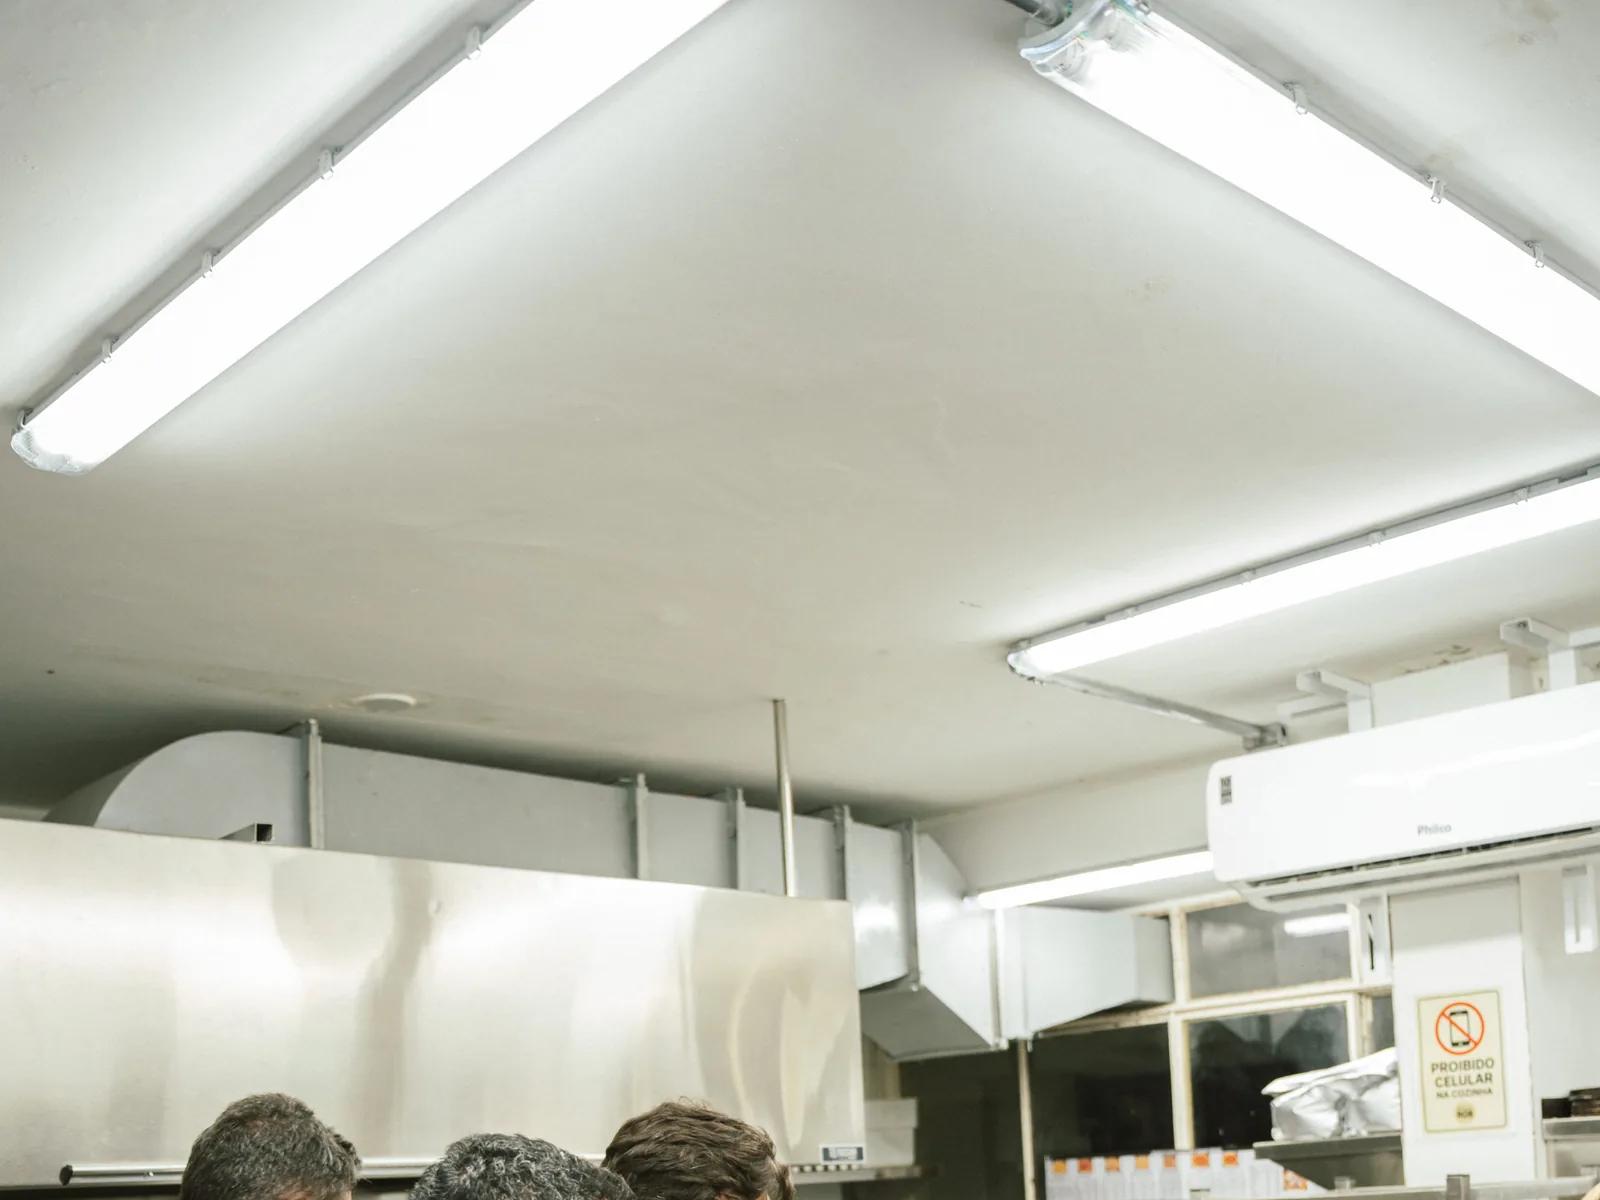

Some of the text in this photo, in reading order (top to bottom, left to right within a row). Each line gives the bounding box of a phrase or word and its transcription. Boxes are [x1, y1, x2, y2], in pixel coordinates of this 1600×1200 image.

[1417, 824, 1452, 836] Philco
[1431, 1058, 1494, 1073] PROIBIDO
[1435, 1072, 1493, 1088] CELULAR
[1451, 1088, 1492, 1098] COZINHA
